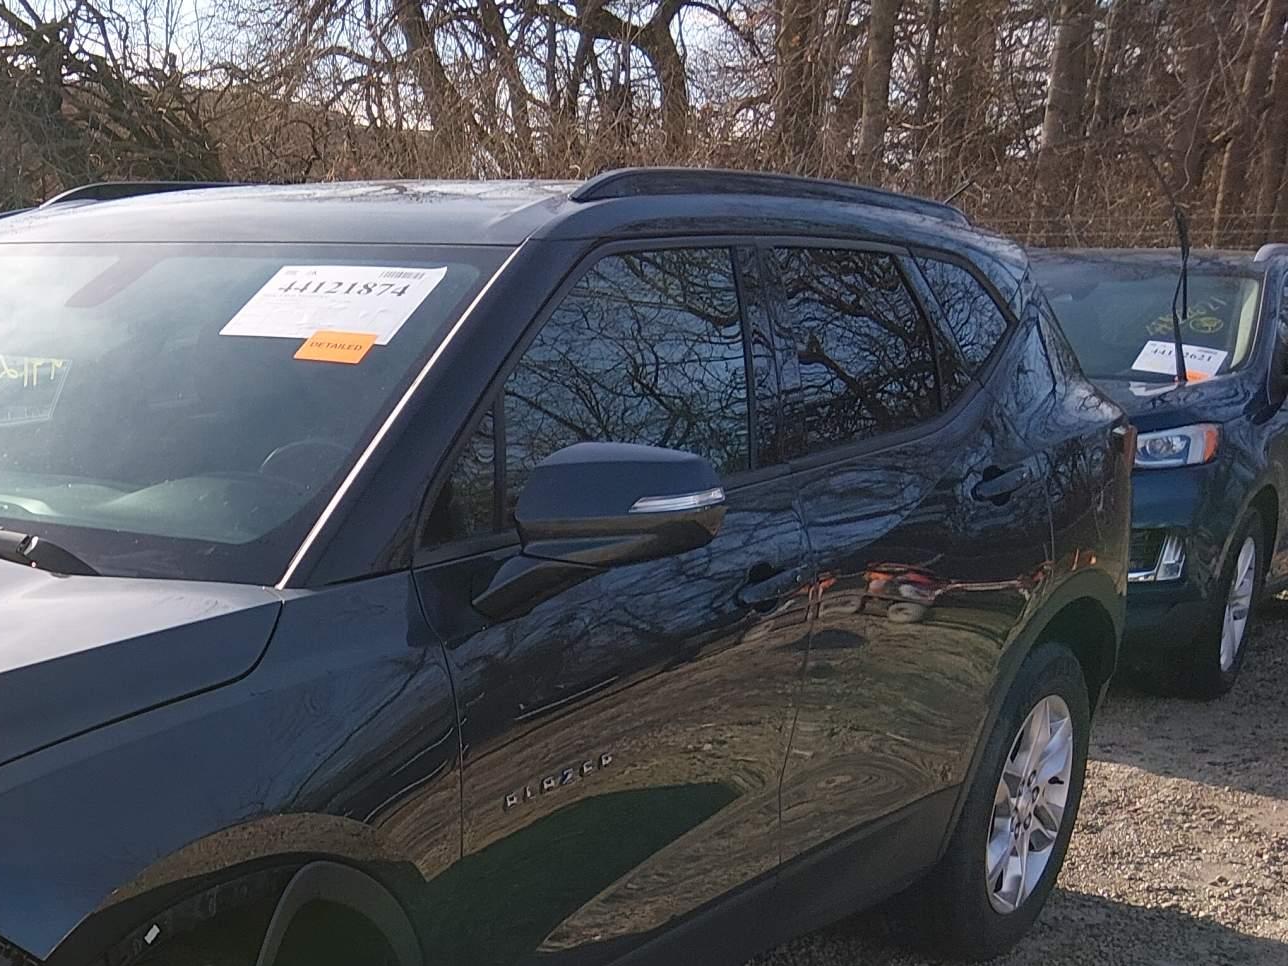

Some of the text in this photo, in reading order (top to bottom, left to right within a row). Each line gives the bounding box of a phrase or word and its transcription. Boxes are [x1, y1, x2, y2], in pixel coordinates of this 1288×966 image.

[278, 280, 411, 297] 44121874
[310, 341, 363, 352] DETAILED
[504, 752, 613, 808] BLAZER
